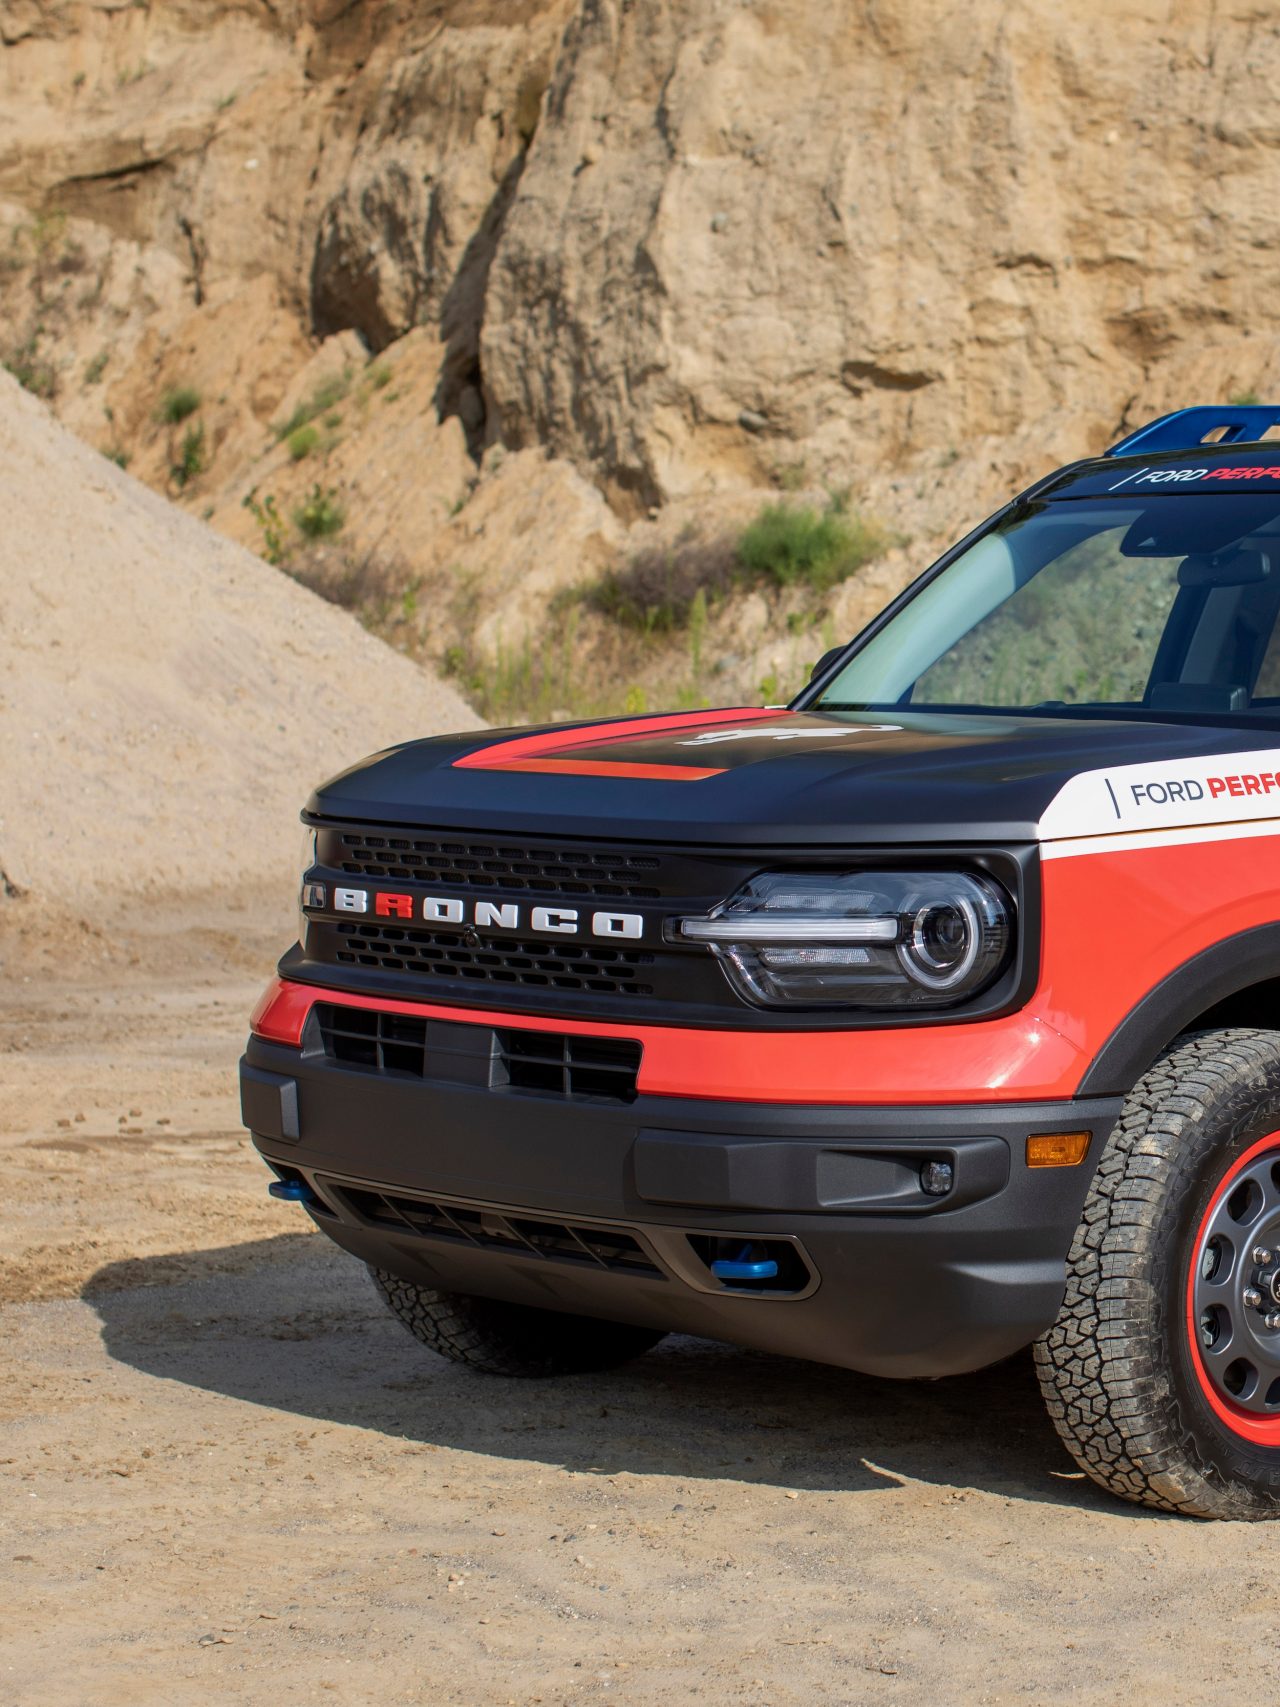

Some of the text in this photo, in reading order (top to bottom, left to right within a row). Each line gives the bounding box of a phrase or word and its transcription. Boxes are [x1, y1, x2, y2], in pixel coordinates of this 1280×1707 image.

[1136, 468, 1208, 484] FORD
[1130, 780, 1204, 806] FORD
[334, 887, 643, 939] BRONCO
